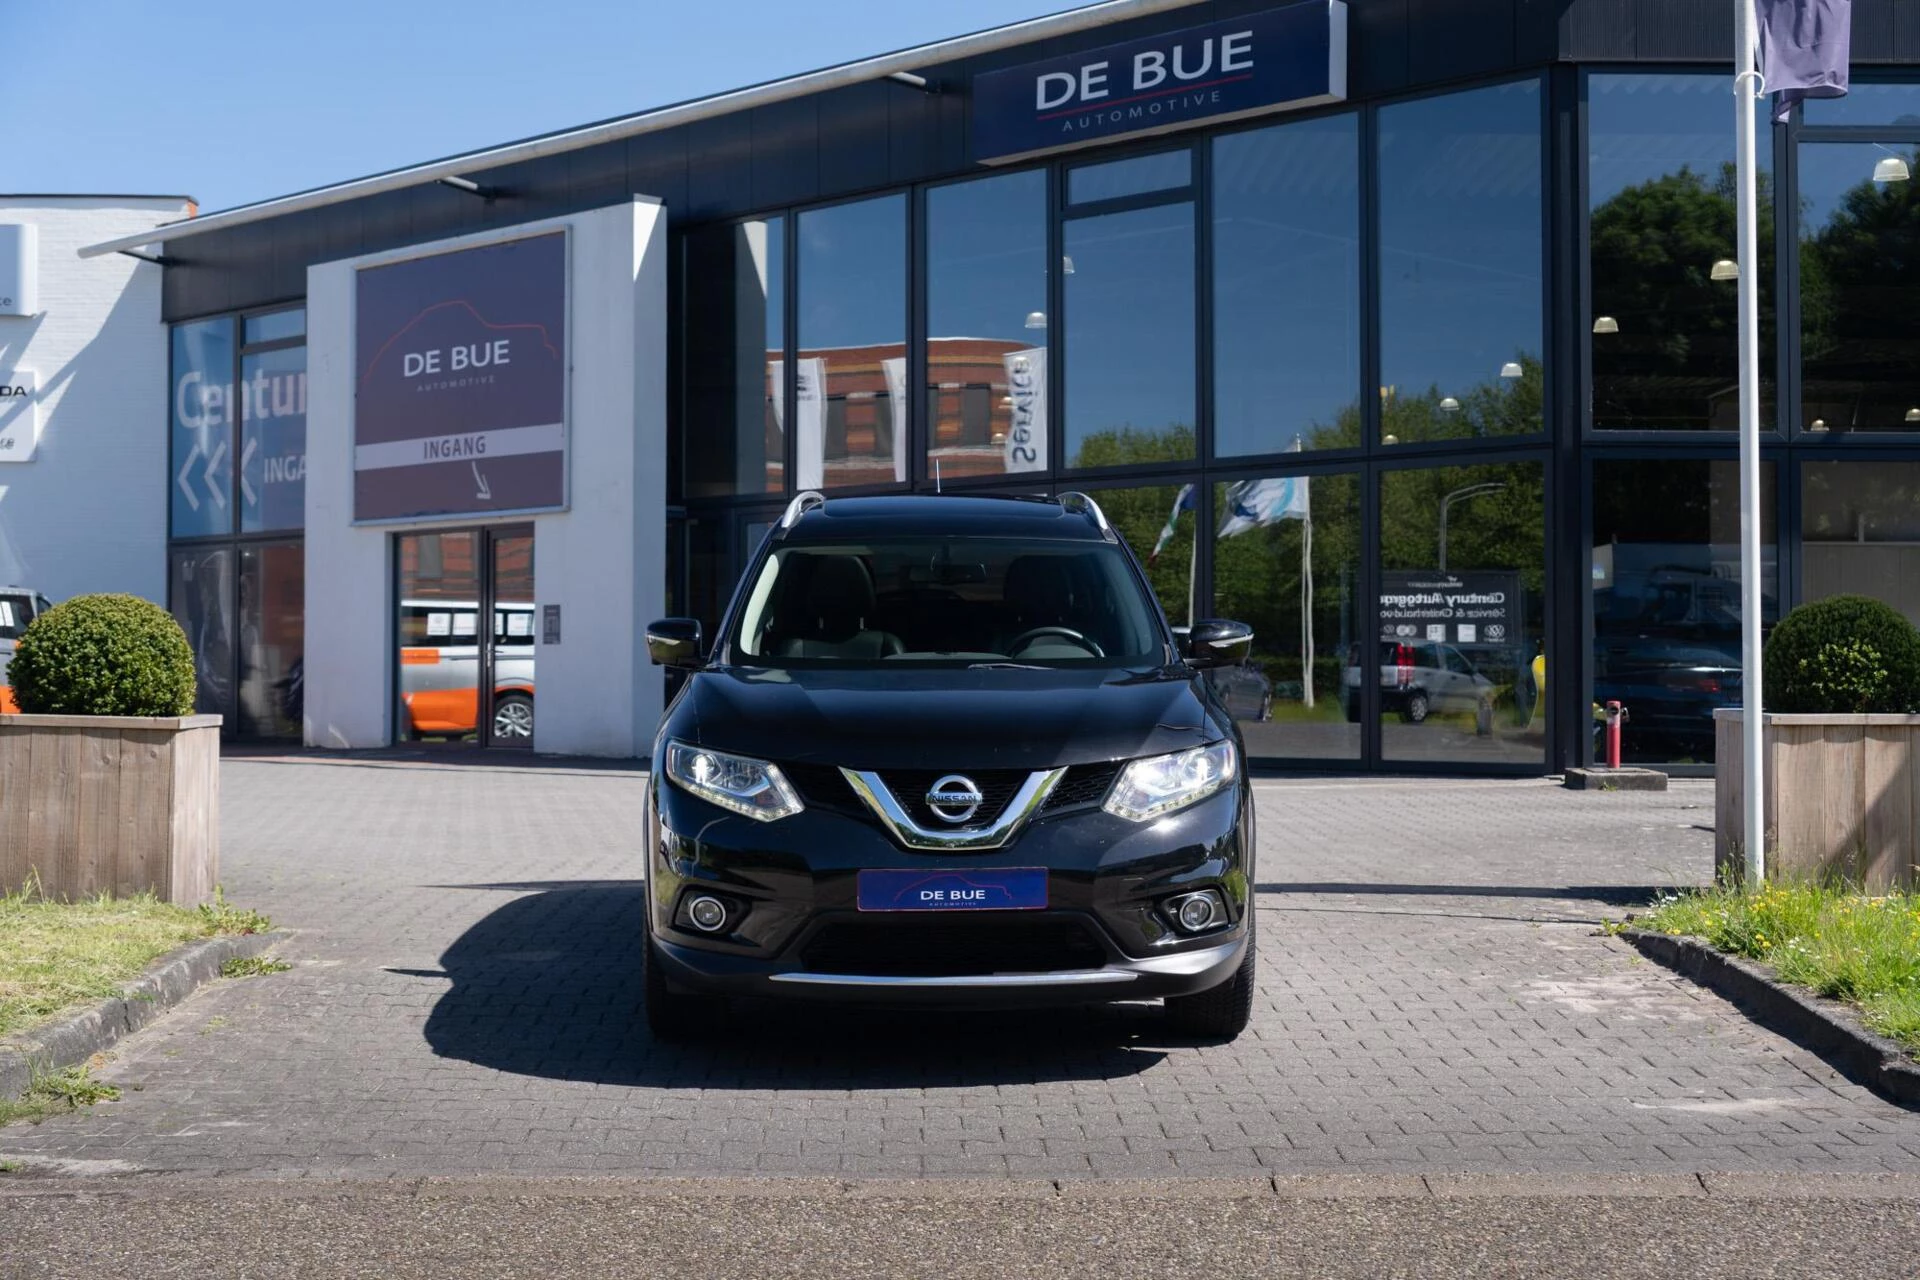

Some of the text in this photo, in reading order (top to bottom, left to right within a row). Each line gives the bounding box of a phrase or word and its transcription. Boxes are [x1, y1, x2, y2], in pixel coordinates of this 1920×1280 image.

[1036, 30, 1254, 110] DE BUE
[1062, 91, 1221, 132] AUTOMOTIVE
[404, 339, 510, 377] DE BUE
[417, 375, 496, 392] AUTOMOTIVE
[423, 436, 487, 459] INGANG
[932, 795, 976, 803] NISSAN
[920, 889, 986, 900] DE BUE
